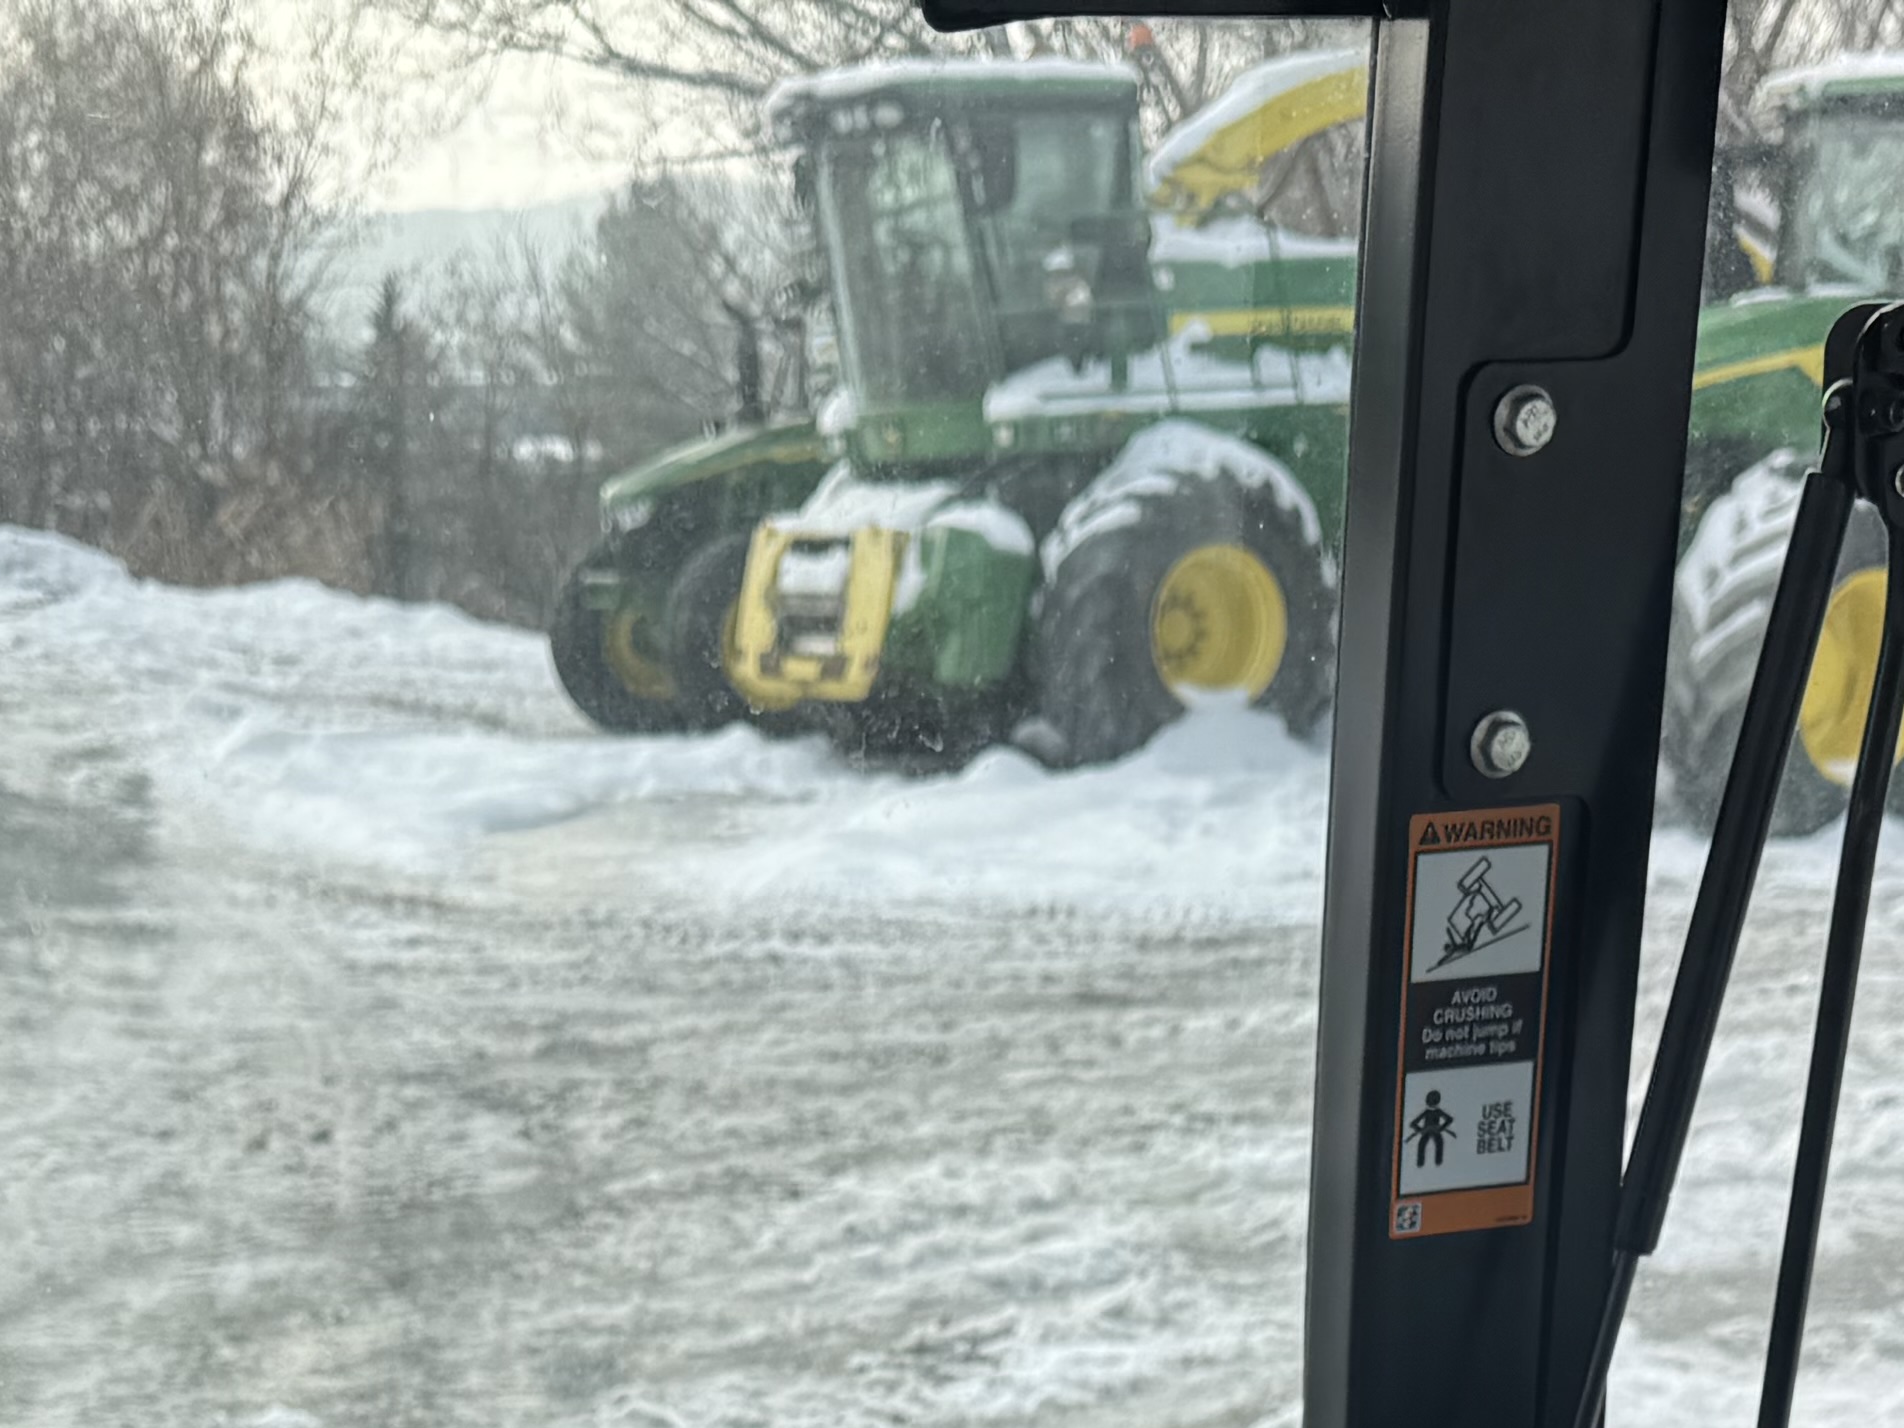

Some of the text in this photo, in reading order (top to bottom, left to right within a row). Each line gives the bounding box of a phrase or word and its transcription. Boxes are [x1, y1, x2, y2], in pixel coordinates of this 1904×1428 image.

[1444, 815, 1552, 843] WARNING
[1451, 986, 1497, 1005] AVOID
[1433, 1003, 1513, 1025] CRUSHING
[1422, 1028, 1443, 1044] Do
[1444, 1025, 1469, 1041] not
[1472, 1022, 1509, 1043] jump
[1425, 1040, 1516, 1060] machine tips
[1482, 1100, 1513, 1120] USE
[1476, 1118, 1516, 1138] SEAT
[1476, 1136, 1515, 1154] BELT
